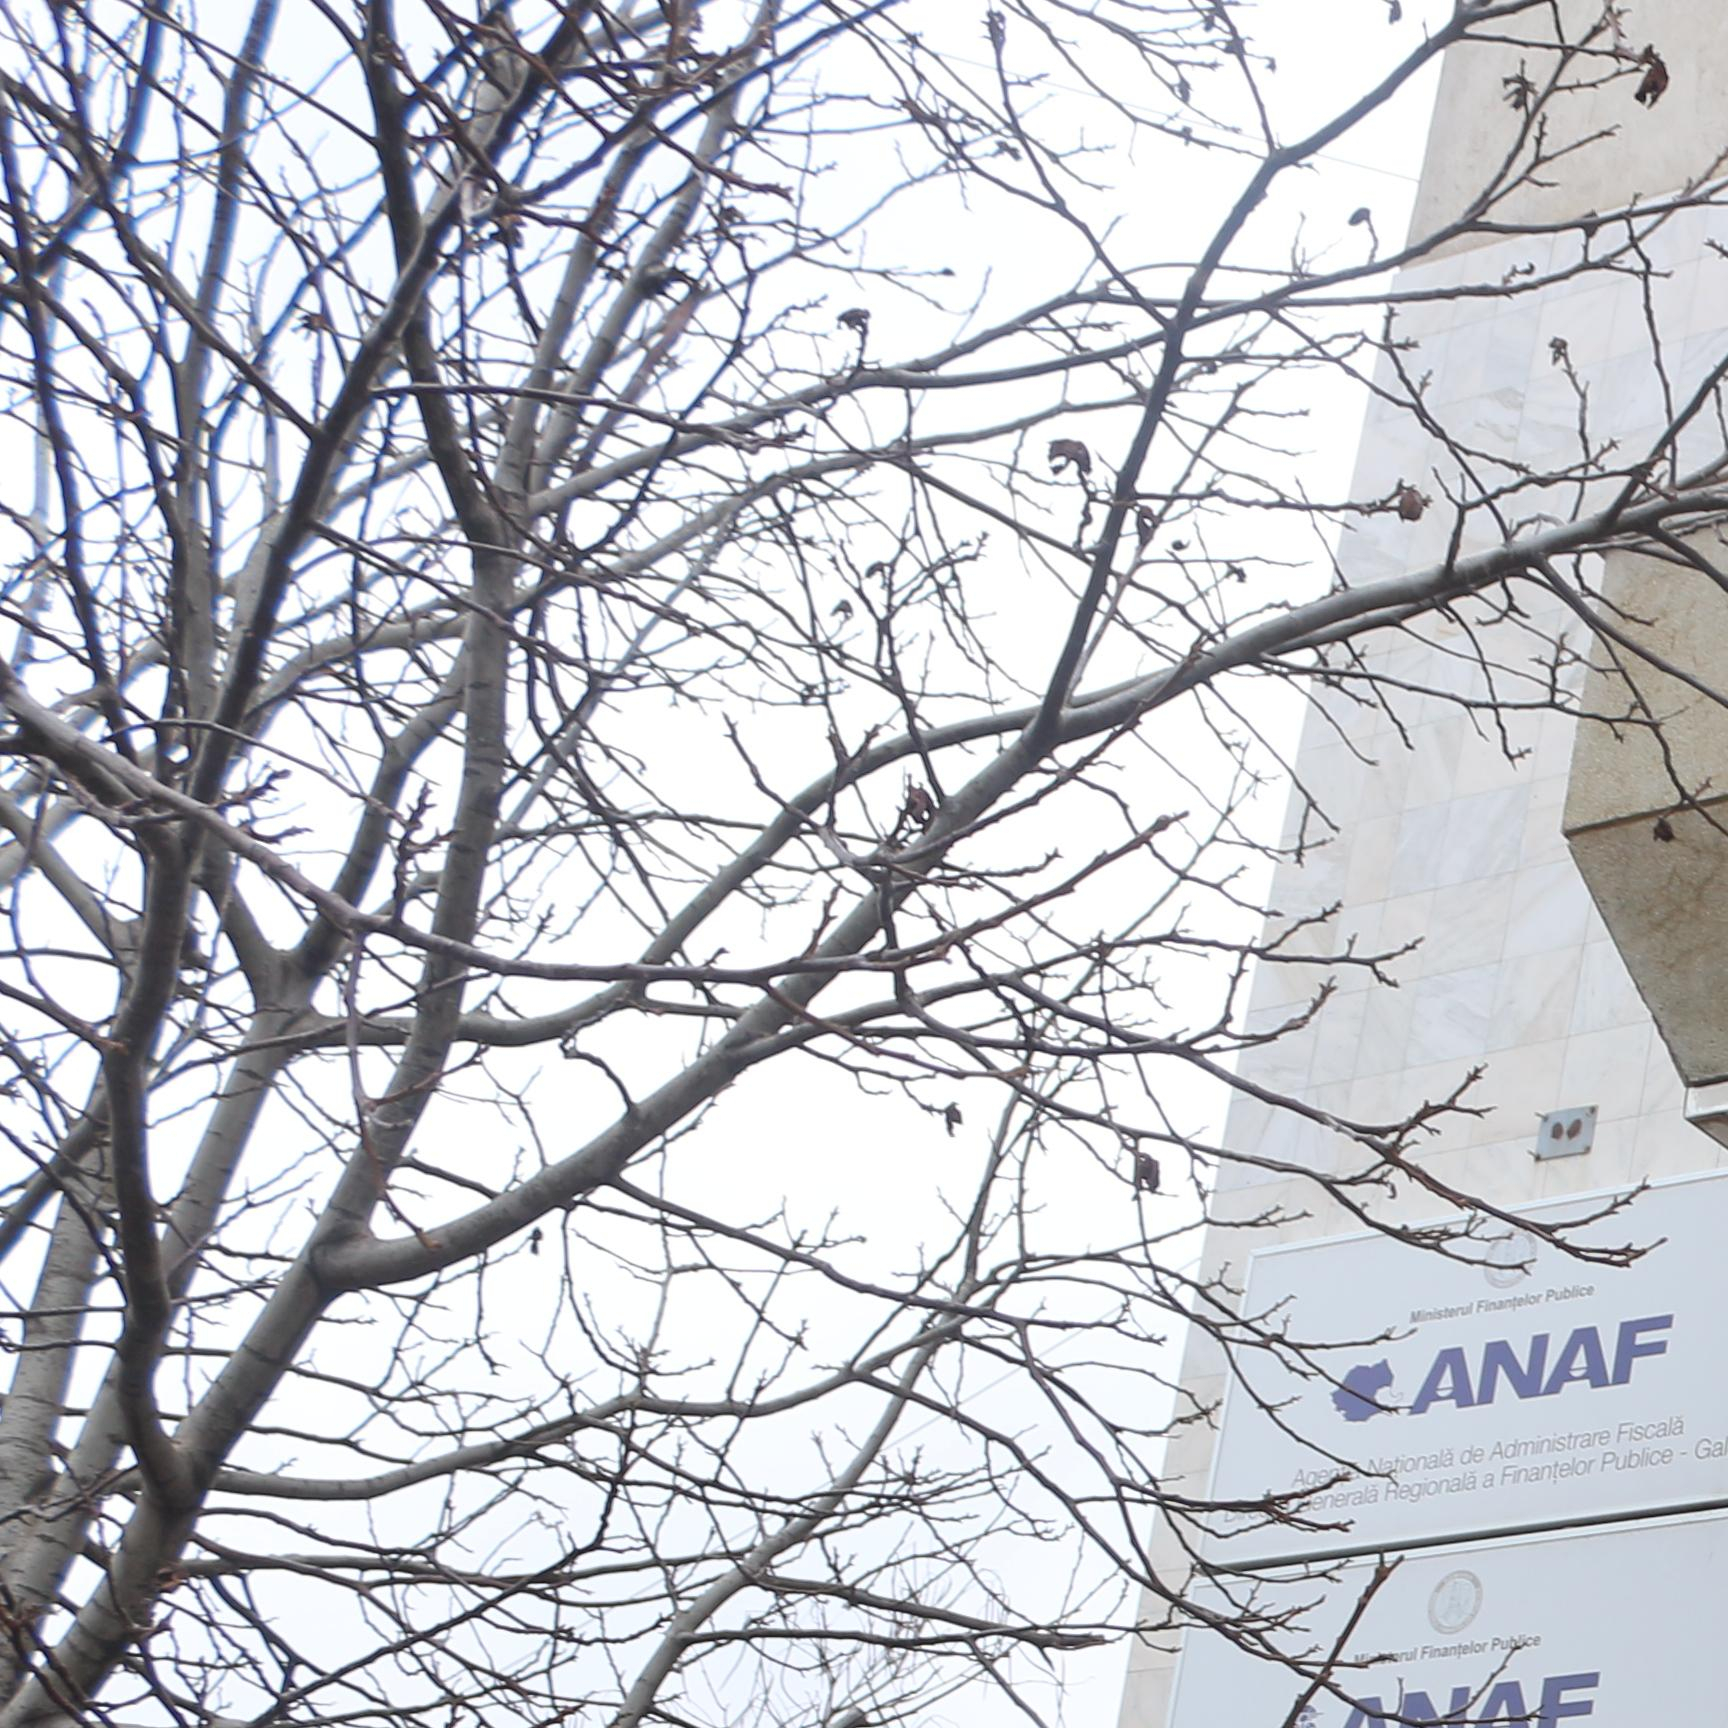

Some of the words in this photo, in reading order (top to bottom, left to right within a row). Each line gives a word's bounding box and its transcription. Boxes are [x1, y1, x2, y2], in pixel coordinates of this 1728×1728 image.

[1410, 1302, 1474, 1324] Ministerul
[1546, 1284, 1595, 1302] Publice
[1408, 1314, 1674, 1416] ANAF
[1460, 1444, 1485, 1465] de
[1489, 1429, 1611, 1460] Administrare
[1616, 1415, 1685, 1443] Fiscală
[1482, 1472, 1495, 1490] a
[1600, 1445, 1673, 1473] Publice
